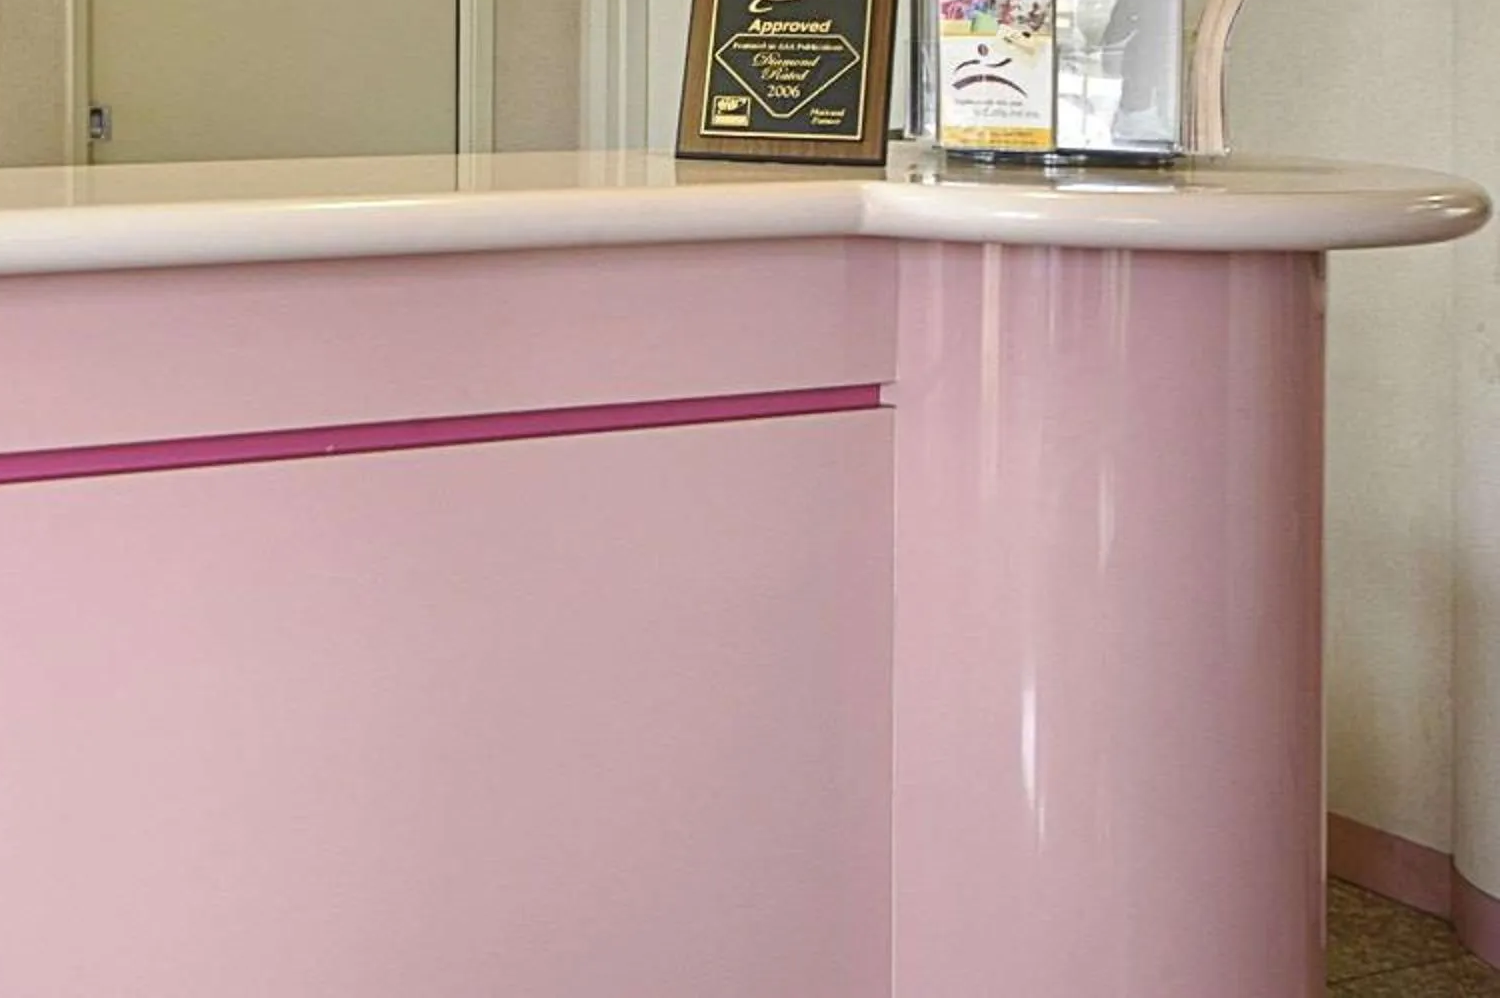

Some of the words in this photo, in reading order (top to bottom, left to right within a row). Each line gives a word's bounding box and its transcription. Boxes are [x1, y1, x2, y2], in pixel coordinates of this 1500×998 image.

[748, 17, 833, 36] Approved
[751, 51, 821, 68] Diamond
[760, 66, 811, 82] Rated
[766, 85, 800, 99] 2006
